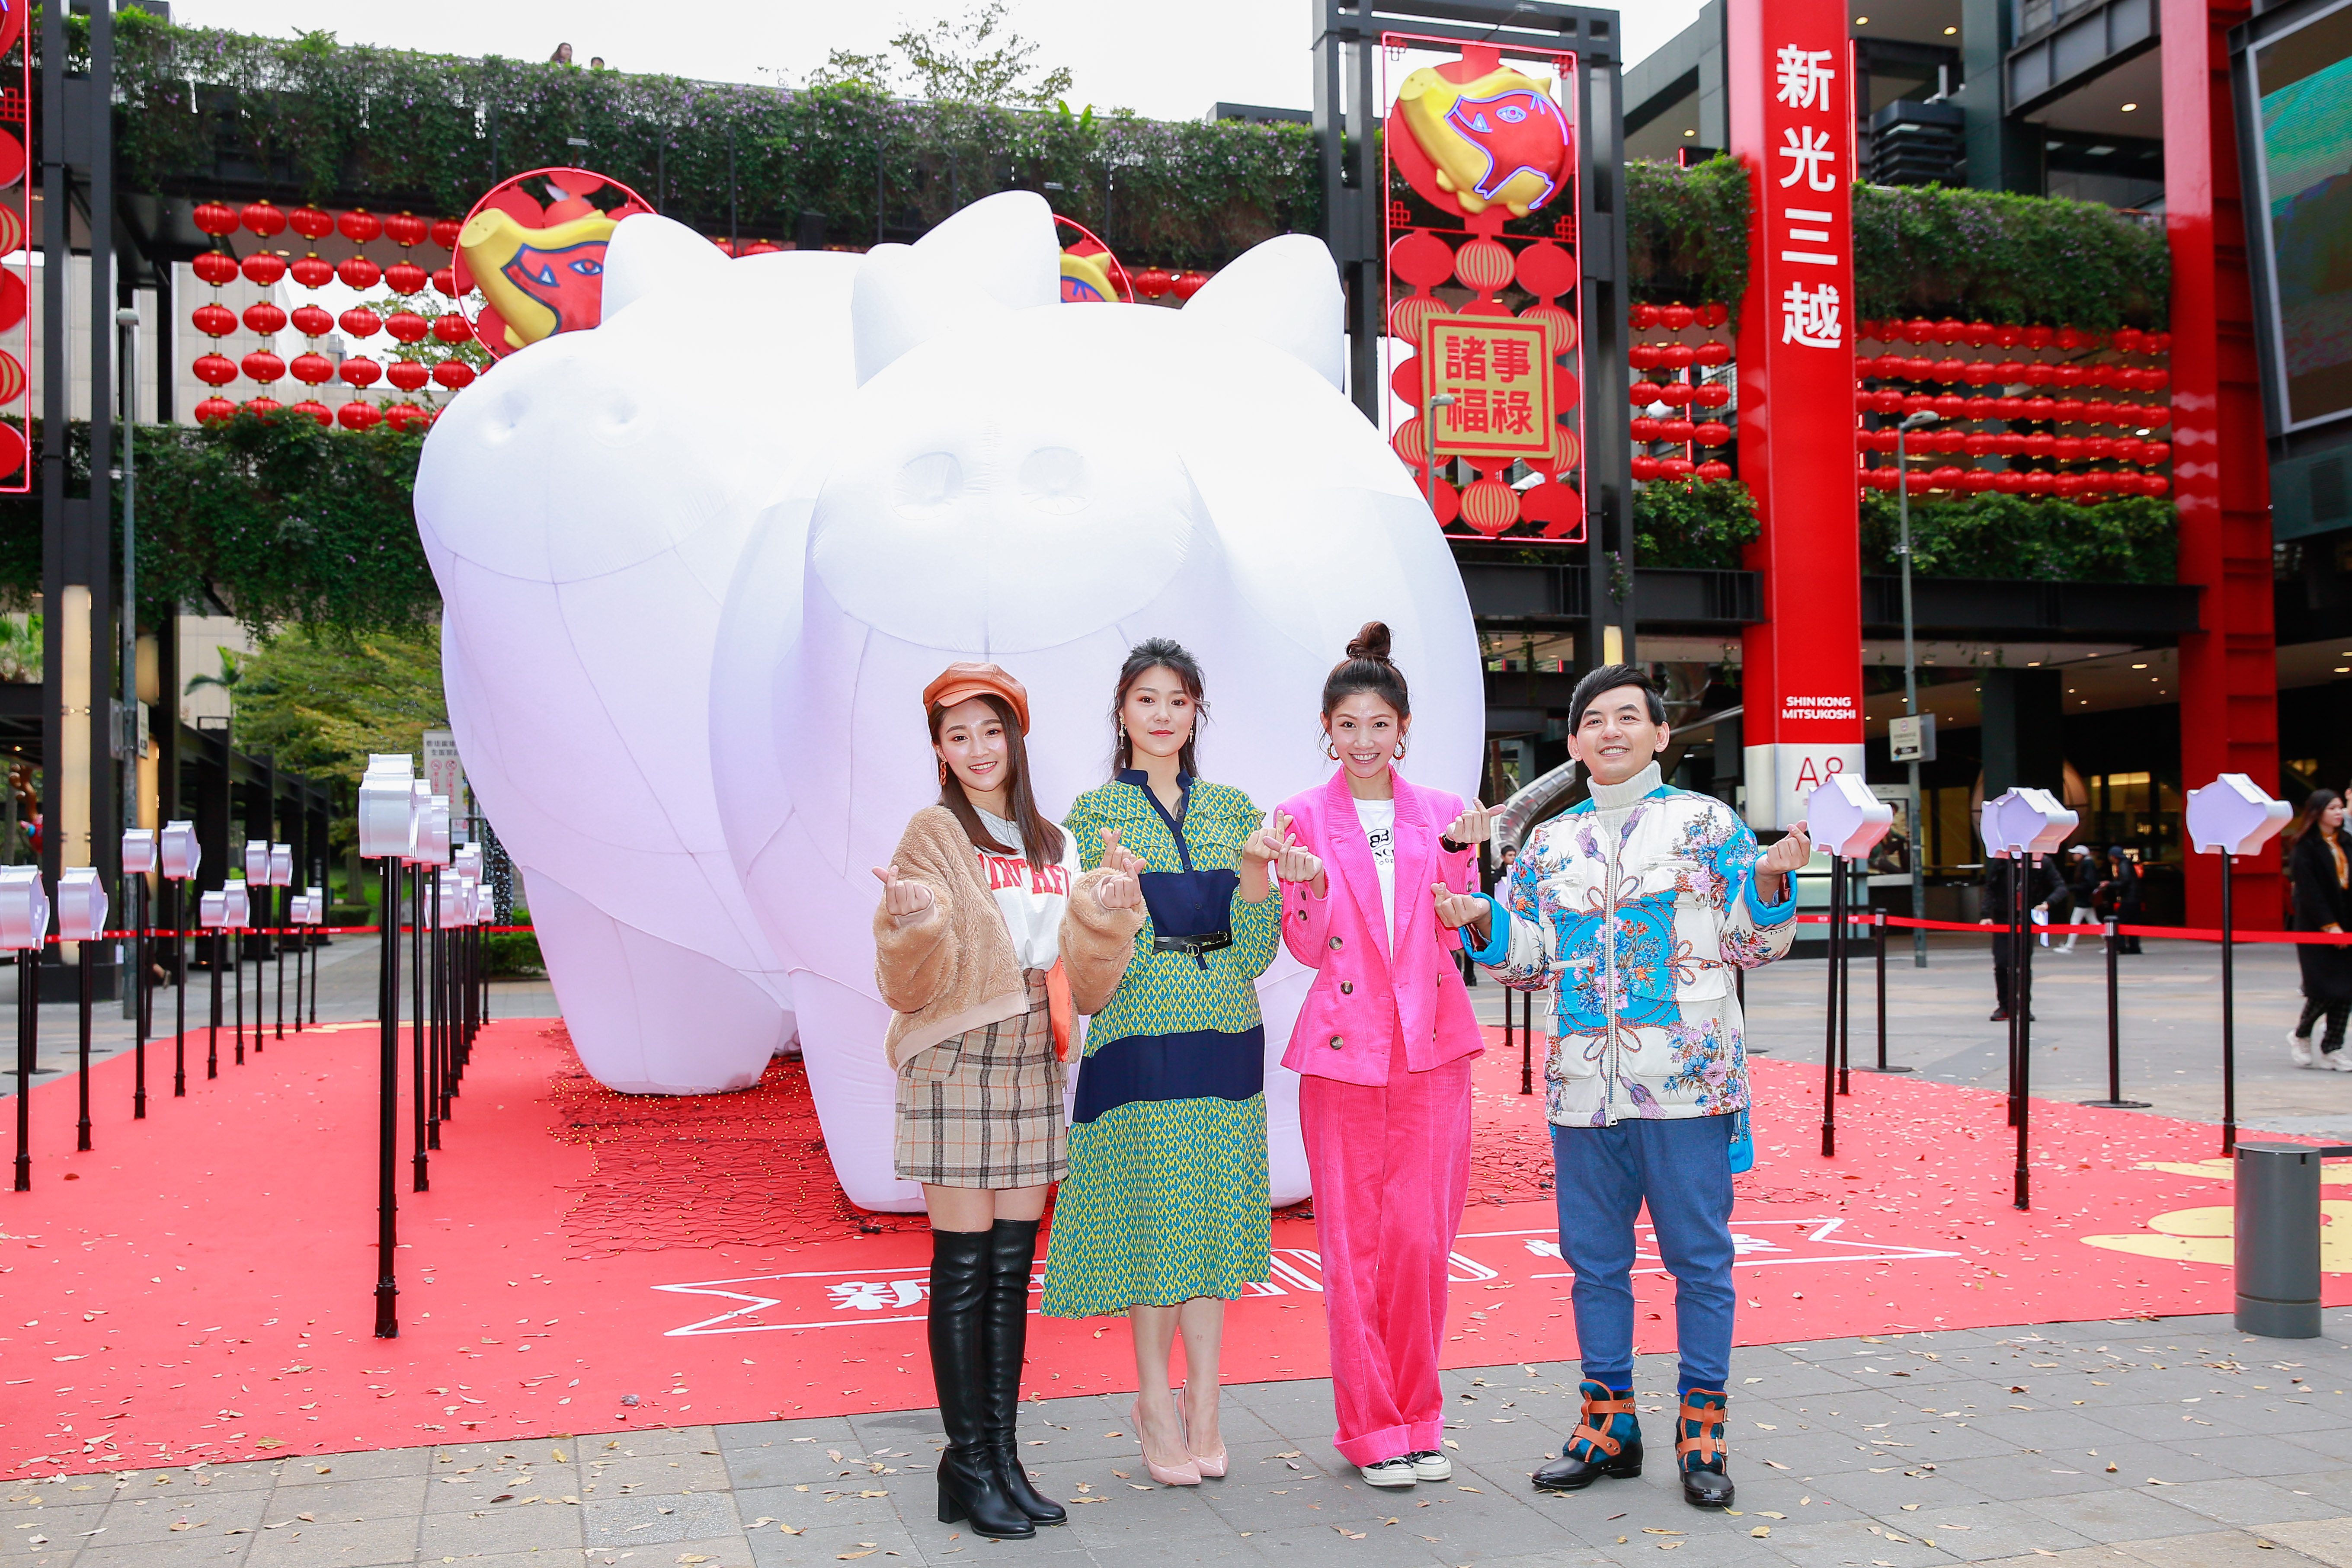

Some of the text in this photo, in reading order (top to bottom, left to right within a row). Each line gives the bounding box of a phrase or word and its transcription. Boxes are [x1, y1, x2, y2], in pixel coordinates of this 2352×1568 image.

[1776, 43, 1842, 349] 新光三越
[1446, 335, 1531, 383] 諸事
[1782, 709, 1856, 719] MITSUKOSHI
[1786, 696, 1852, 707] SHIN KONG
